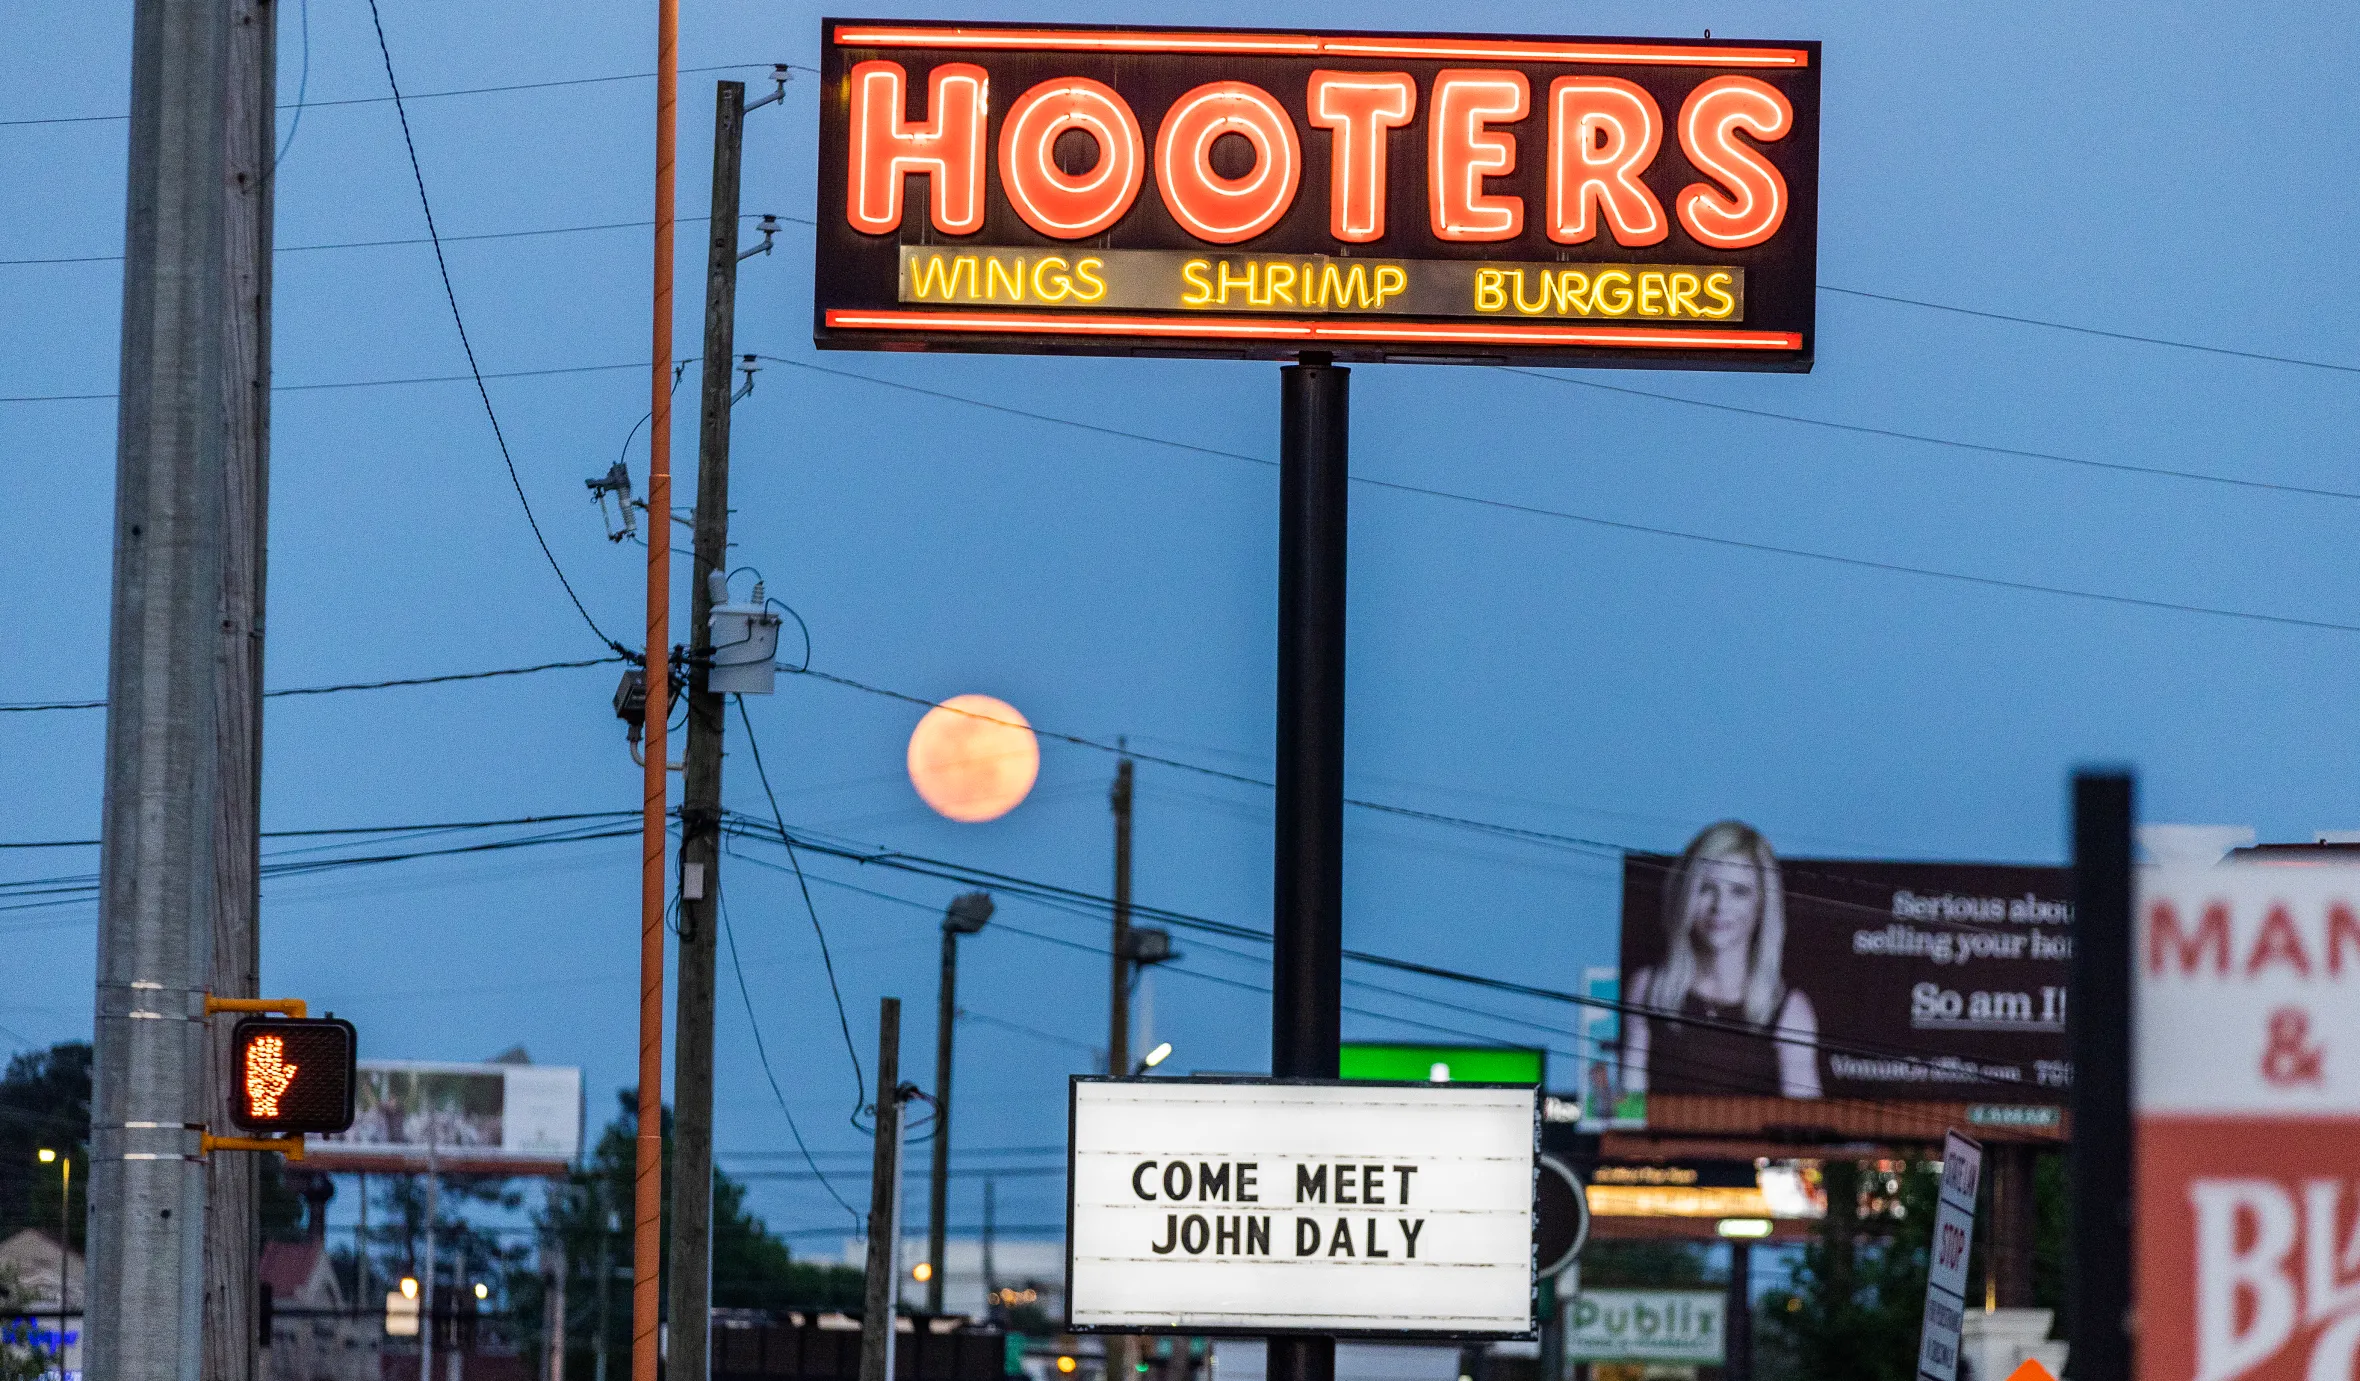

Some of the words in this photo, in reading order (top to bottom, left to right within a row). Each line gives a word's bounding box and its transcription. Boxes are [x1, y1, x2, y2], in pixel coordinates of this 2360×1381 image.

[847, 60, 1794, 249] HOOTERS
[909, 253, 1107, 303] WINGS
[1180, 258, 1408, 310] SHRIMP
[1475, 266, 1736, 317] BURGERS
[1893, 890, 2006, 921] Serious
[2009, 892, 2075, 924] abou
[1853, 924, 1953, 964] selling
[1955, 931, 2027, 965] your
[1912, 982, 1964, 1021] So
[1968, 990, 2032, 1022] am
[2258, 1006, 2326, 1088] &
[1132, 1160, 1259, 1201] COME
[1297, 1163, 1418, 1205] MEET
[1152, 1214, 1271, 1255] JOHN
[1296, 1216, 1425, 1259] DALY
[1940, 1222, 1965, 1271] STOP
